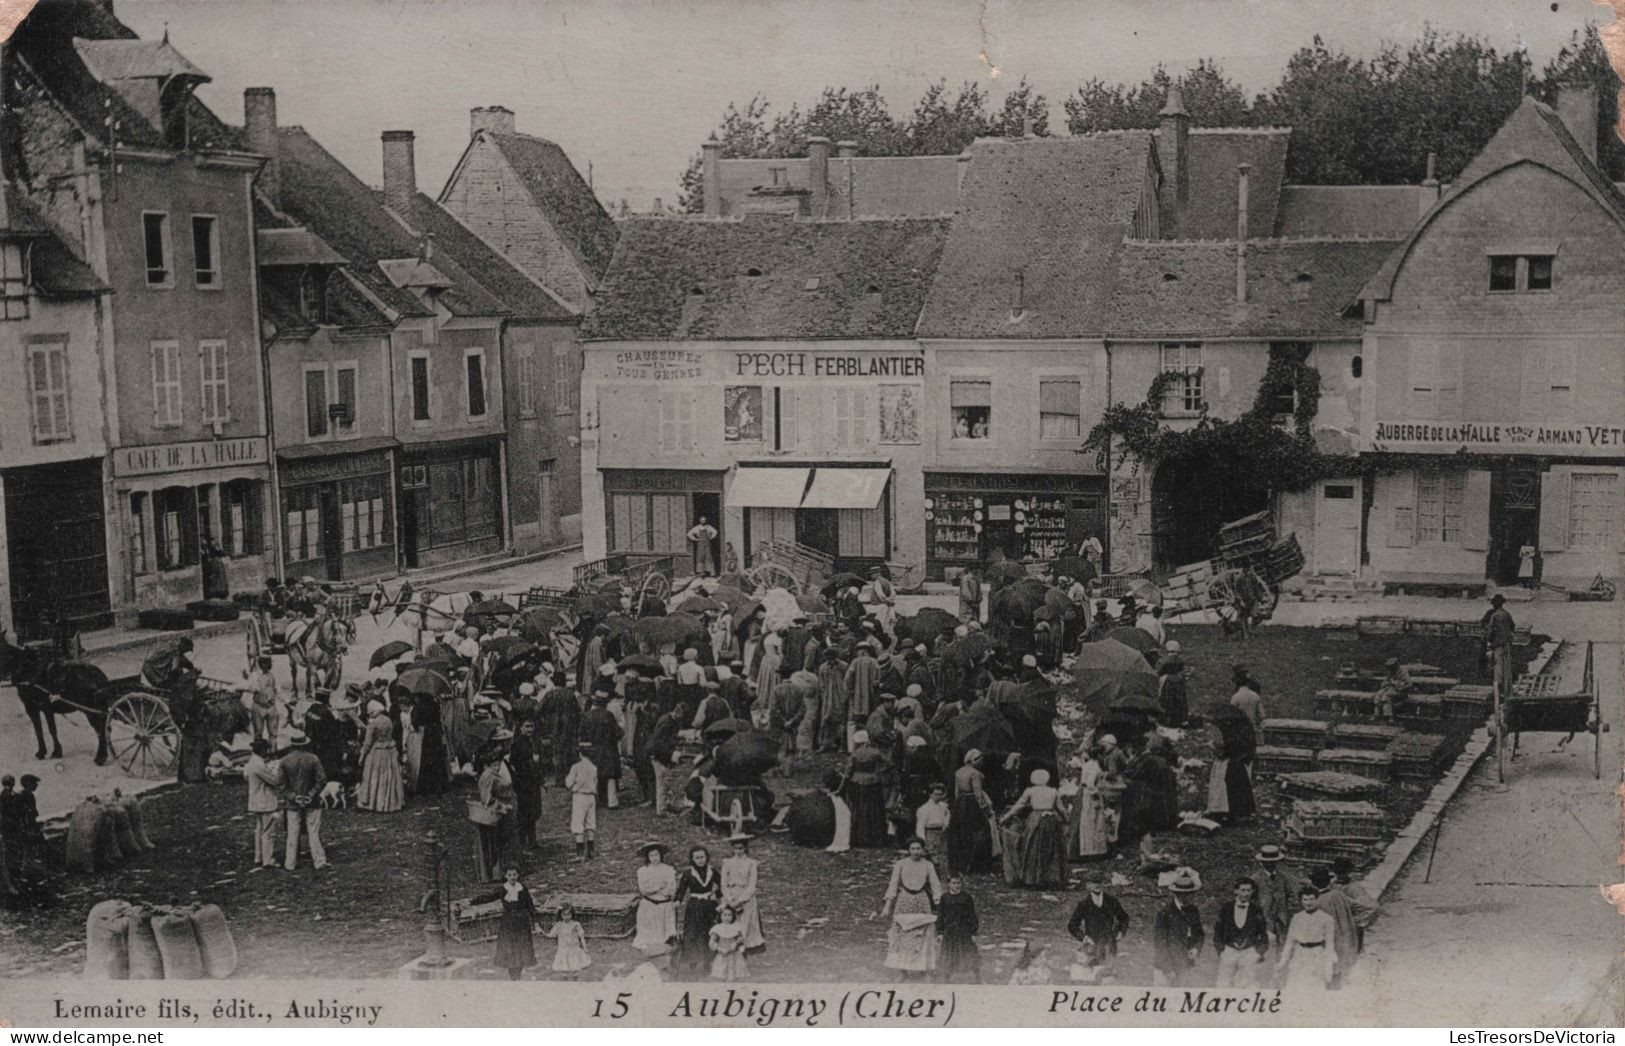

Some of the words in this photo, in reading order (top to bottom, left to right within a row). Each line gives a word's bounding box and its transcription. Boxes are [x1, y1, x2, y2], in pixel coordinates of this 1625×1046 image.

[617, 350, 702, 363] CHAUSSURES
[736, 353, 806, 376] PECH
[815, 356, 925, 376] FERBLANTIER
[1376, 422, 1430, 441] AUBERGE
[1431, 427, 1443, 441] DE
[1446, 427, 1458, 442] LA
[1459, 423, 1500, 442] HALLE
[1537, 427, 1582, 444] ARMAND
[168, 447, 183, 467] DE
[191, 445, 207, 465] LA
[215, 441, 257, 463] HALLE
